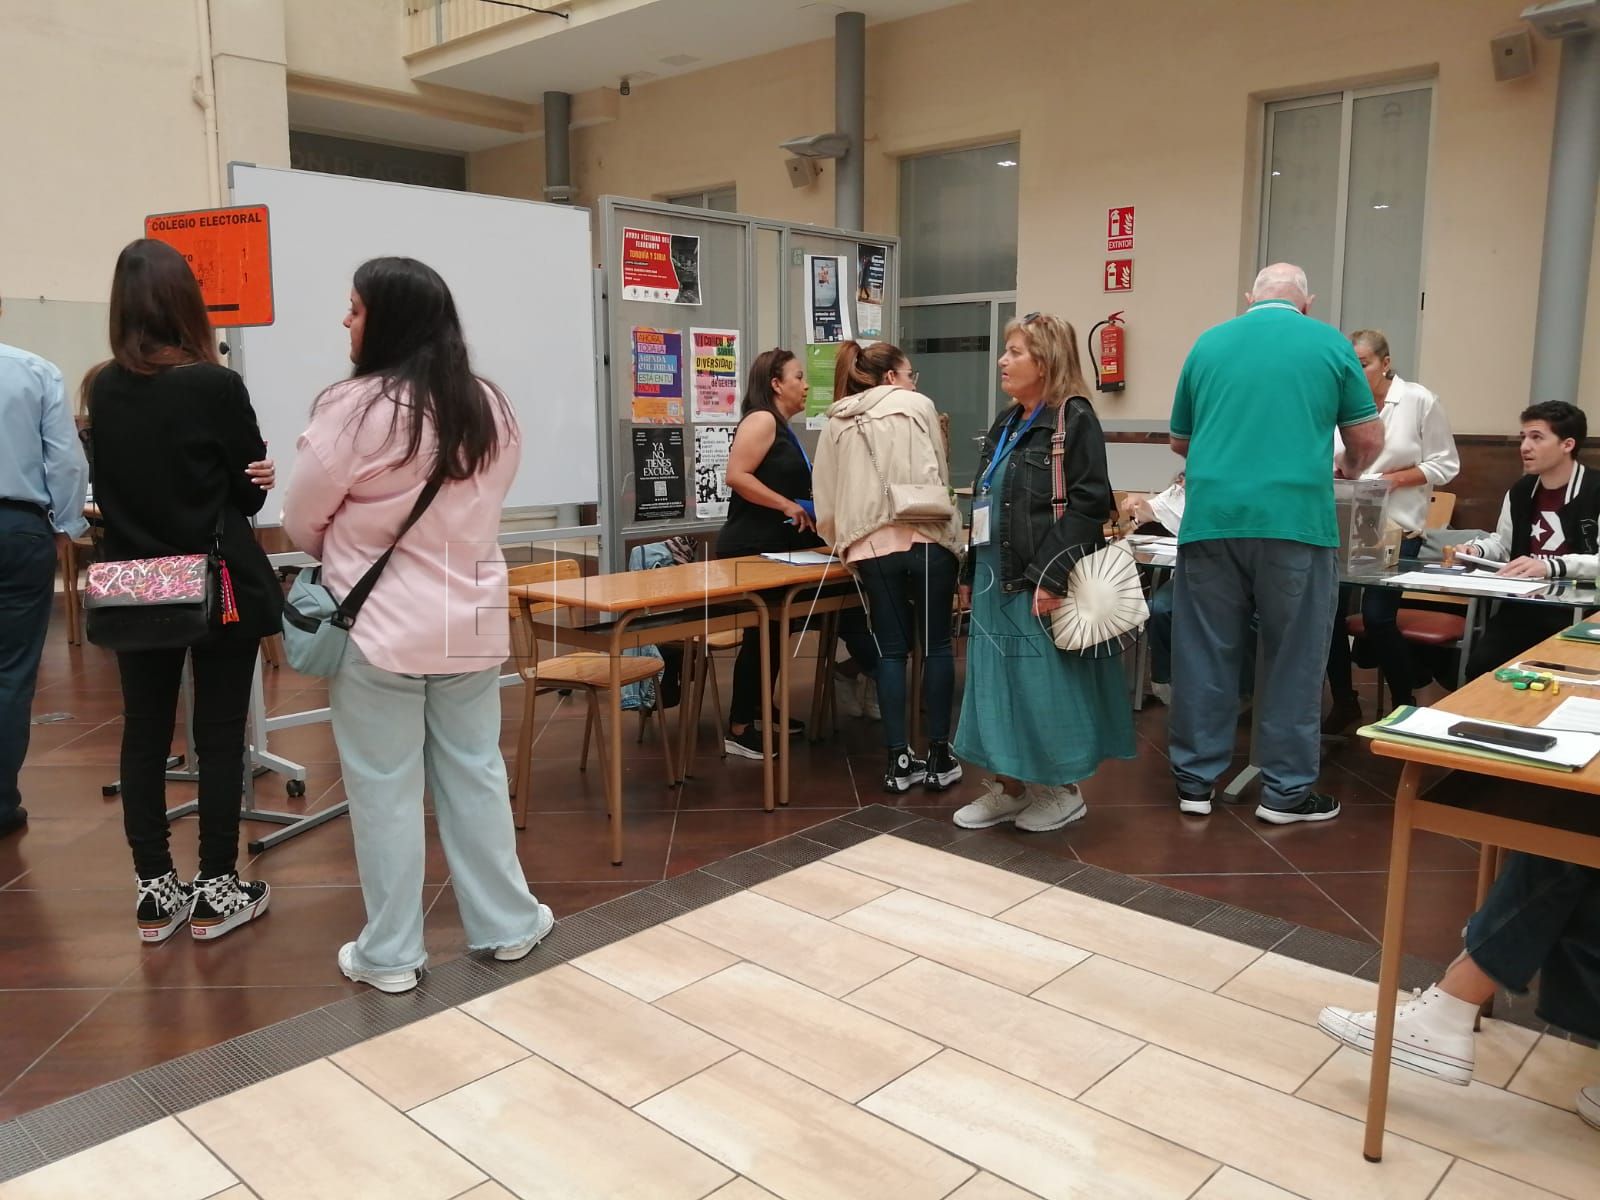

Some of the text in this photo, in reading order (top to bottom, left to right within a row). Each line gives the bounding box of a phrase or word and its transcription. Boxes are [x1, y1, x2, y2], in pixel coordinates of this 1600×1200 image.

[151, 212, 262, 232] COLEGIO ELECTORAL
[1108, 239, 1132, 249] EXTINTOR
[696, 357, 733, 370] DIVERSIDAD
[652, 442, 664, 451] YA
[652, 450, 665, 460] NO
[645, 458, 672, 468] TIENES
[643, 466, 675, 476] EXCUSA
